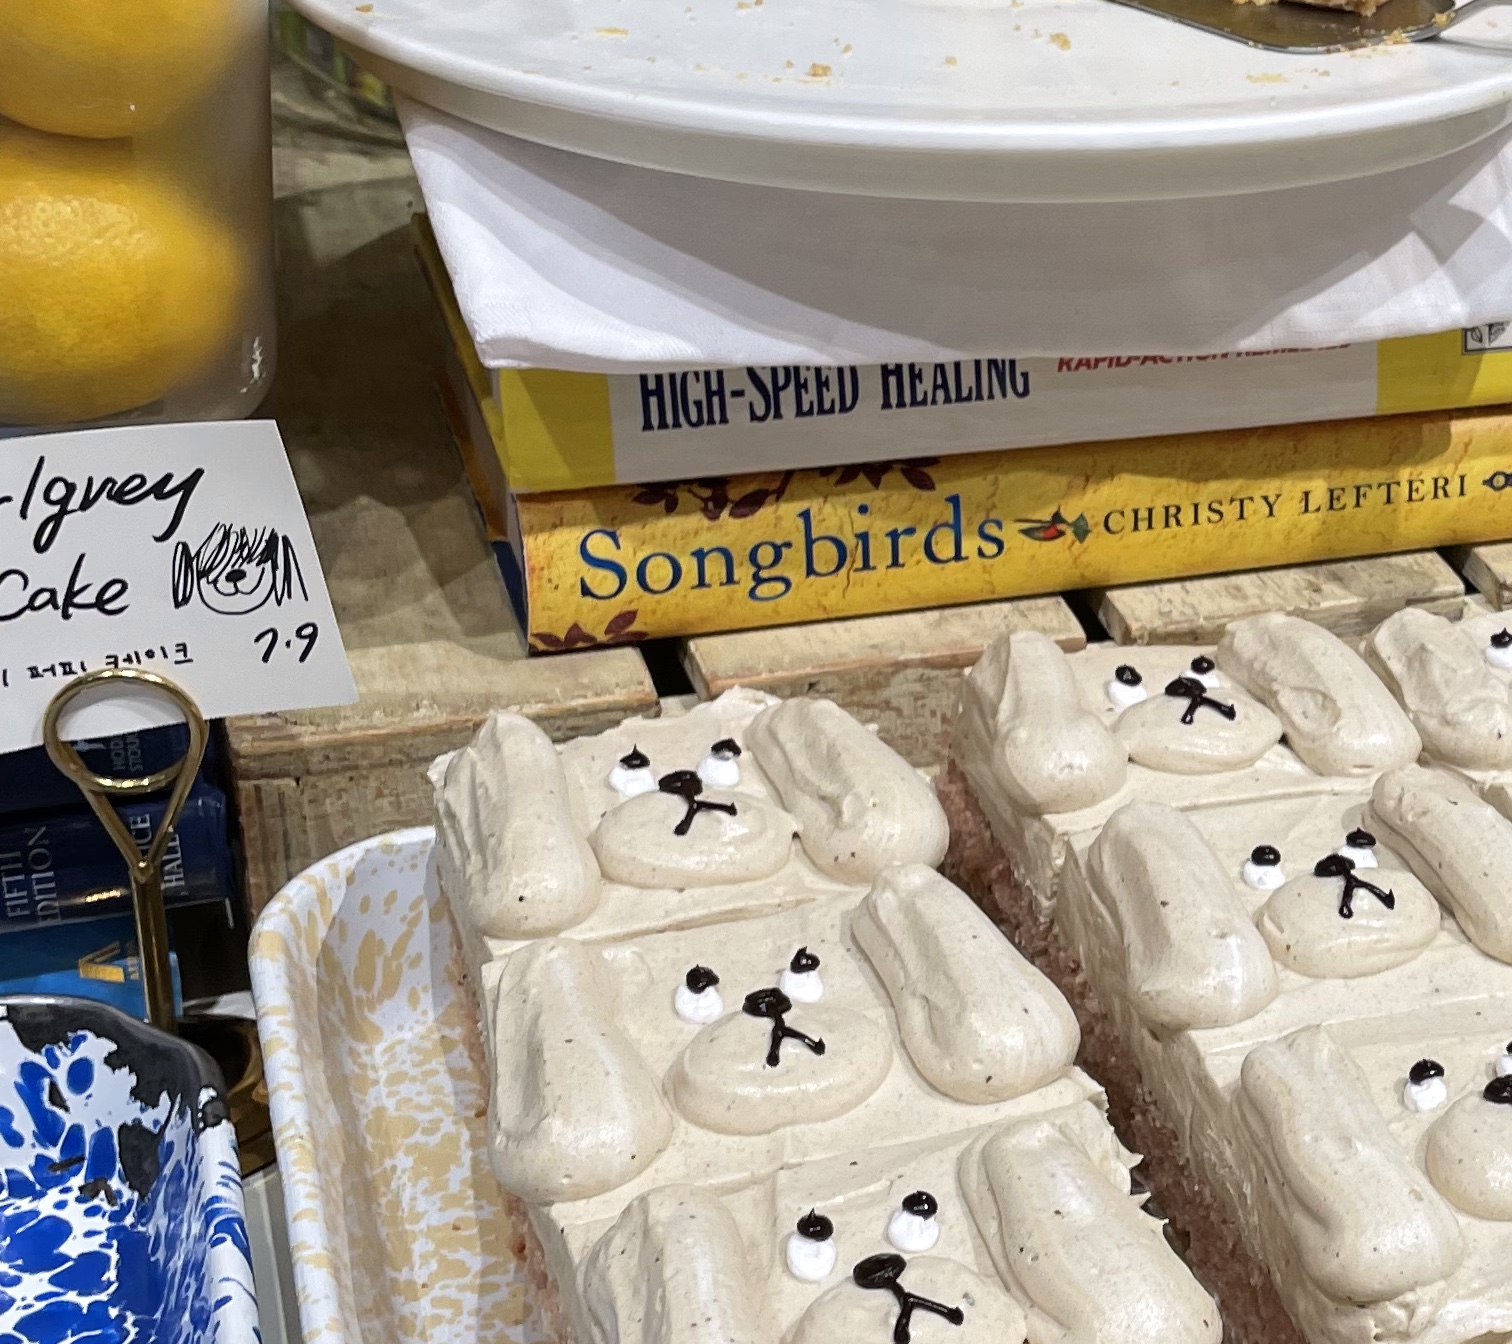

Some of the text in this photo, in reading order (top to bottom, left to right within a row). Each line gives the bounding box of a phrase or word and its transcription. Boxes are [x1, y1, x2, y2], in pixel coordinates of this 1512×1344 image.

[640, 358, 1030, 431] HIGH-SPEED HEALING
[1104, 474, 1467, 535] CHRISTY LEFTERI
[579, 493, 1005, 601] Songbirds
[254, 623, 319, 663] 7.9
